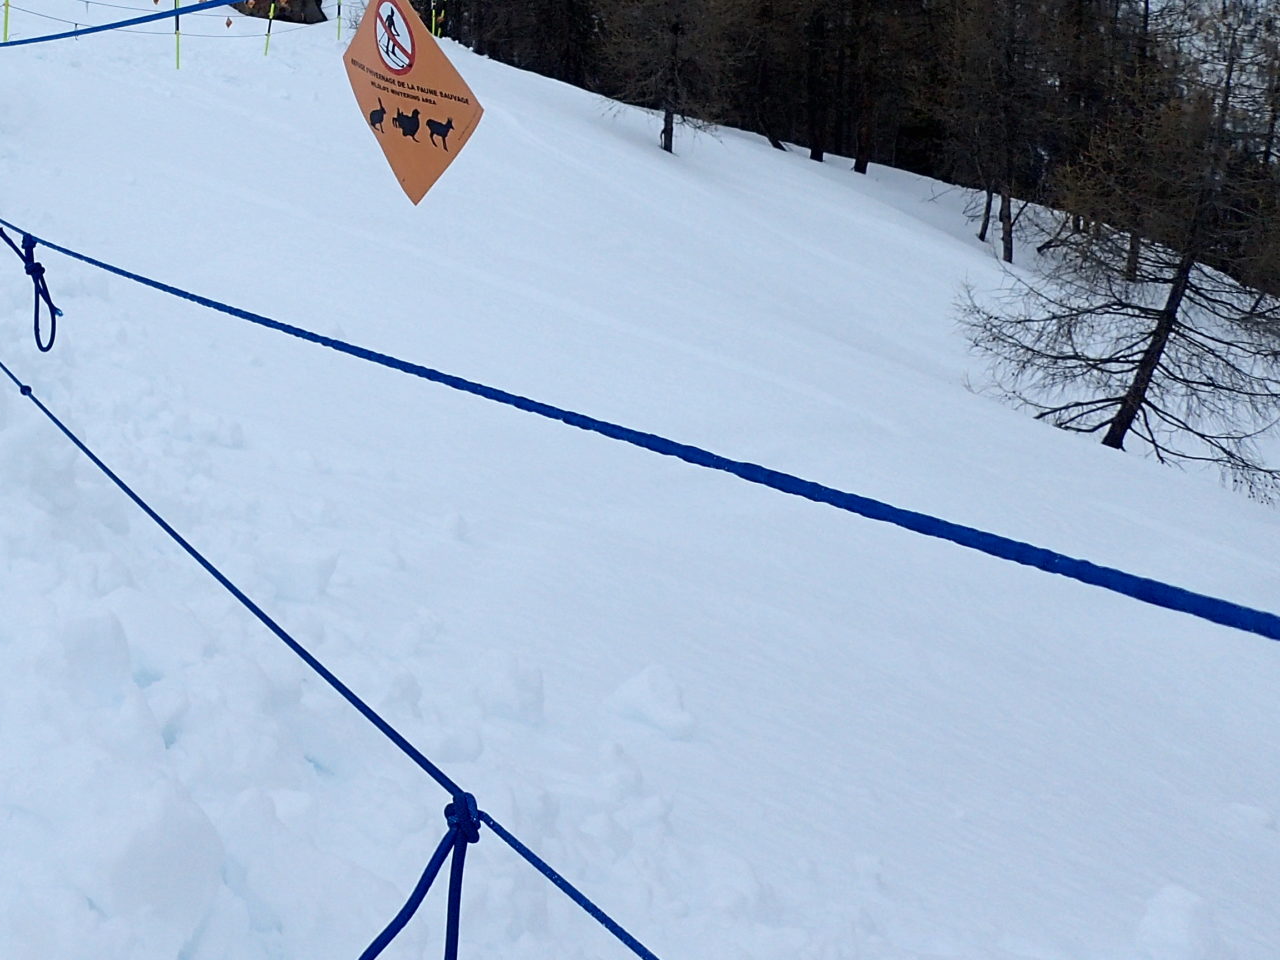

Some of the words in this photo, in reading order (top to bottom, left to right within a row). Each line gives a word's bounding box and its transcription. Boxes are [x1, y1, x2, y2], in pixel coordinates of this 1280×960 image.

[397, 80, 406, 89] DE
[406, 83, 416, 91] LA
[416, 85, 438, 97] FAUNE
[439, 91, 470, 105] SAUVAGE
